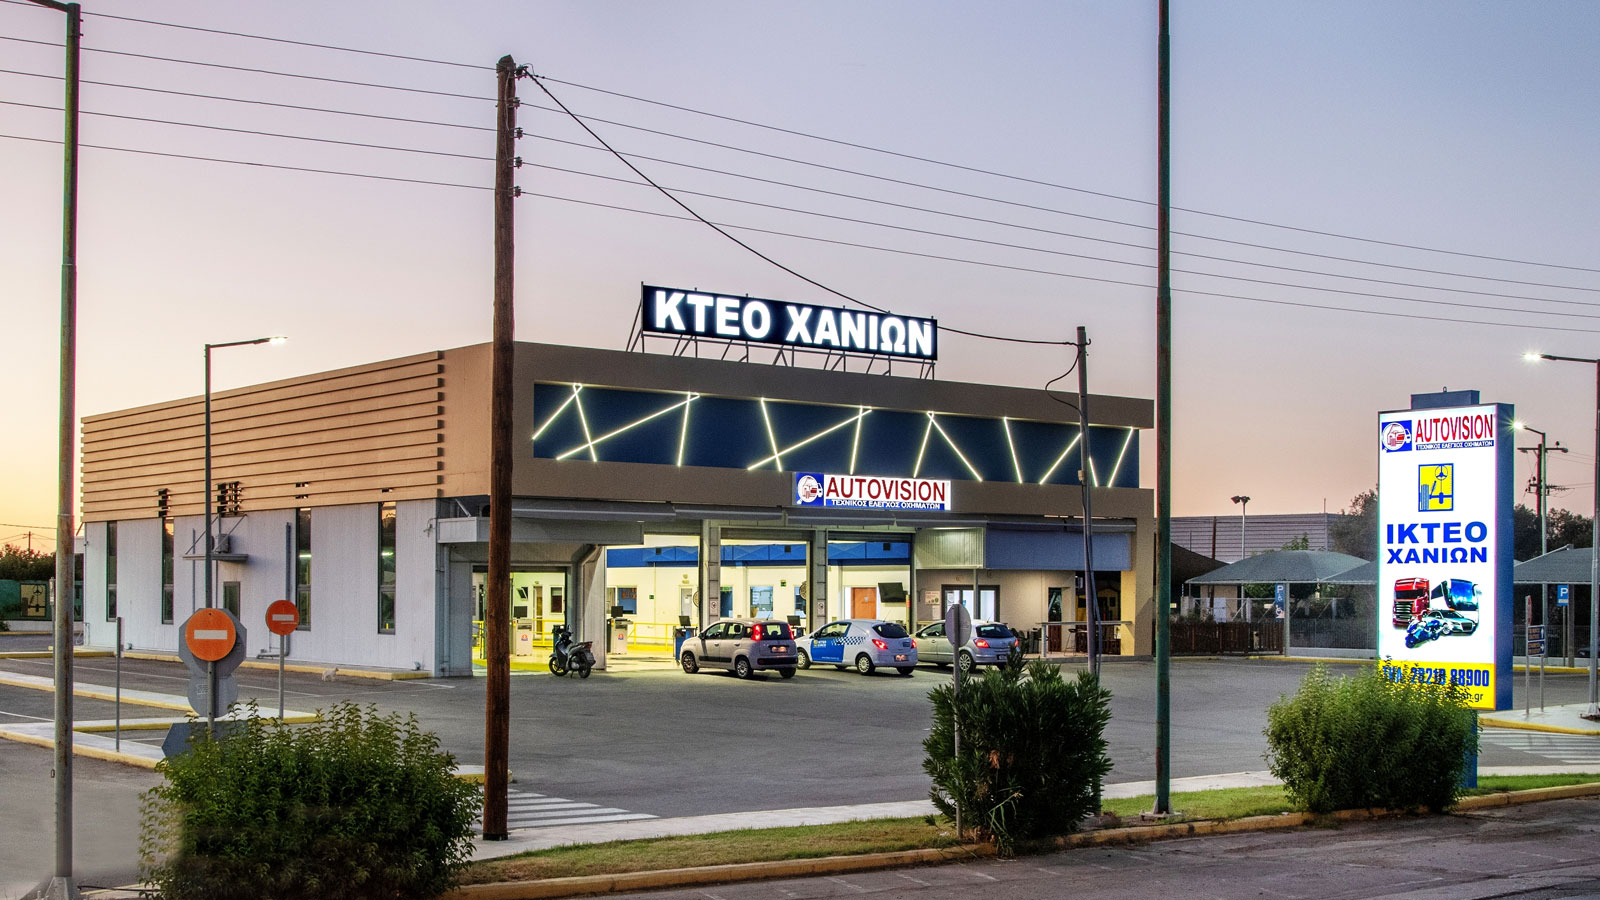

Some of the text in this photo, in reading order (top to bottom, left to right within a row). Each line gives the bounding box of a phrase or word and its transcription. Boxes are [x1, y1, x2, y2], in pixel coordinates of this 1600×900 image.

[655, 290, 933, 356] ΚΤΕΟ ΧΑΝΙΩΝ
[1415, 414, 1493, 442] AUTOVISION
[826, 477, 945, 501] AUTOVISION
[831, 499, 867, 507] ΤΕΧΝΙΚΟΣ
[902, 502, 940, 510] ΟΧΗΜΑΤΩΝ
[1387, 521, 1487, 544] ΙΚΤΕΟ
[1387, 547, 1487, 564] ΧΑΝΙΩΝ
[1560, 587, 1569, 597] P
[1451, 669, 1490, 686] 88900
